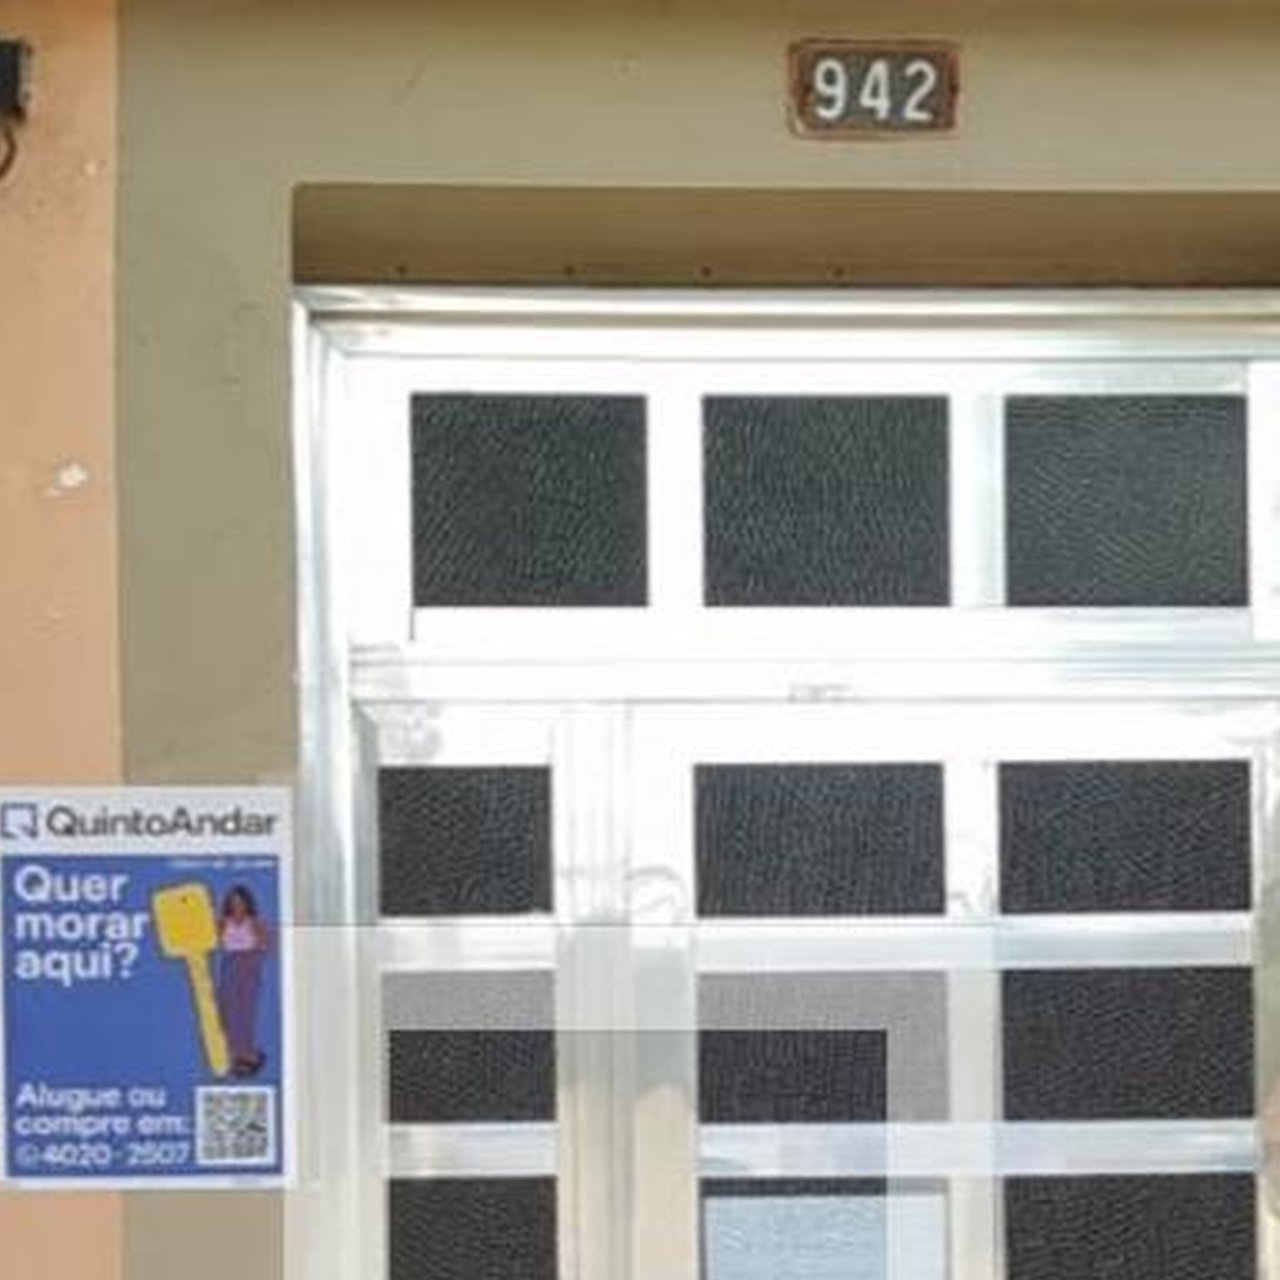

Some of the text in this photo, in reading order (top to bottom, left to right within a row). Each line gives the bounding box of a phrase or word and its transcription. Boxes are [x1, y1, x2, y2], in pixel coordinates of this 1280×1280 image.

[815, 58, 937, 120] 942
[46, 804, 277, 836] QuintoAndar
[14, 865, 128, 902] Quer
[14, 913, 147, 939] morar
[15, 942, 138, 987] aqui?
[16, 1082, 166, 1113] Alugue ou
[15, 1116, 130, 1139] compre
